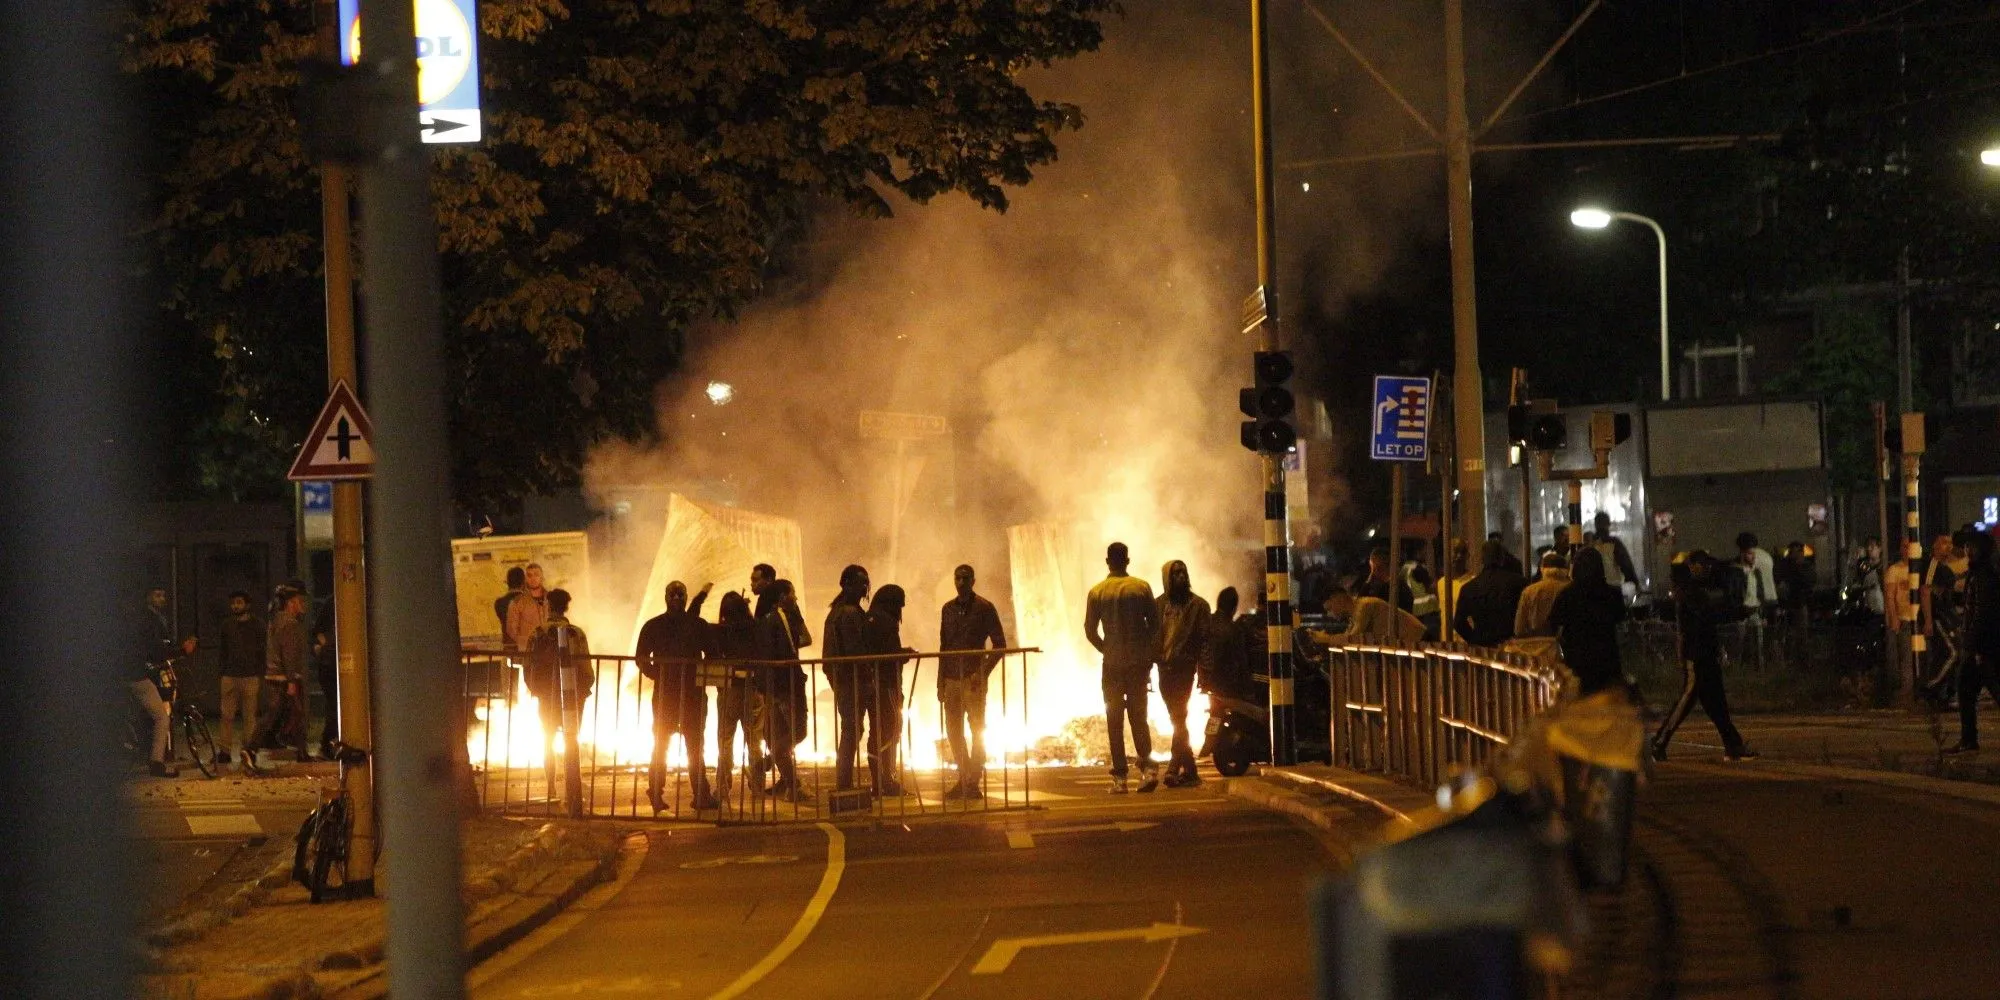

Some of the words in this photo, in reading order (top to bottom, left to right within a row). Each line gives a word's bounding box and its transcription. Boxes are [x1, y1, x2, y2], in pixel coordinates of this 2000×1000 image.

[416, 36, 462, 58] DL
[1377, 443, 1402, 455] LET
[1404, 444, 1423, 456] OP
